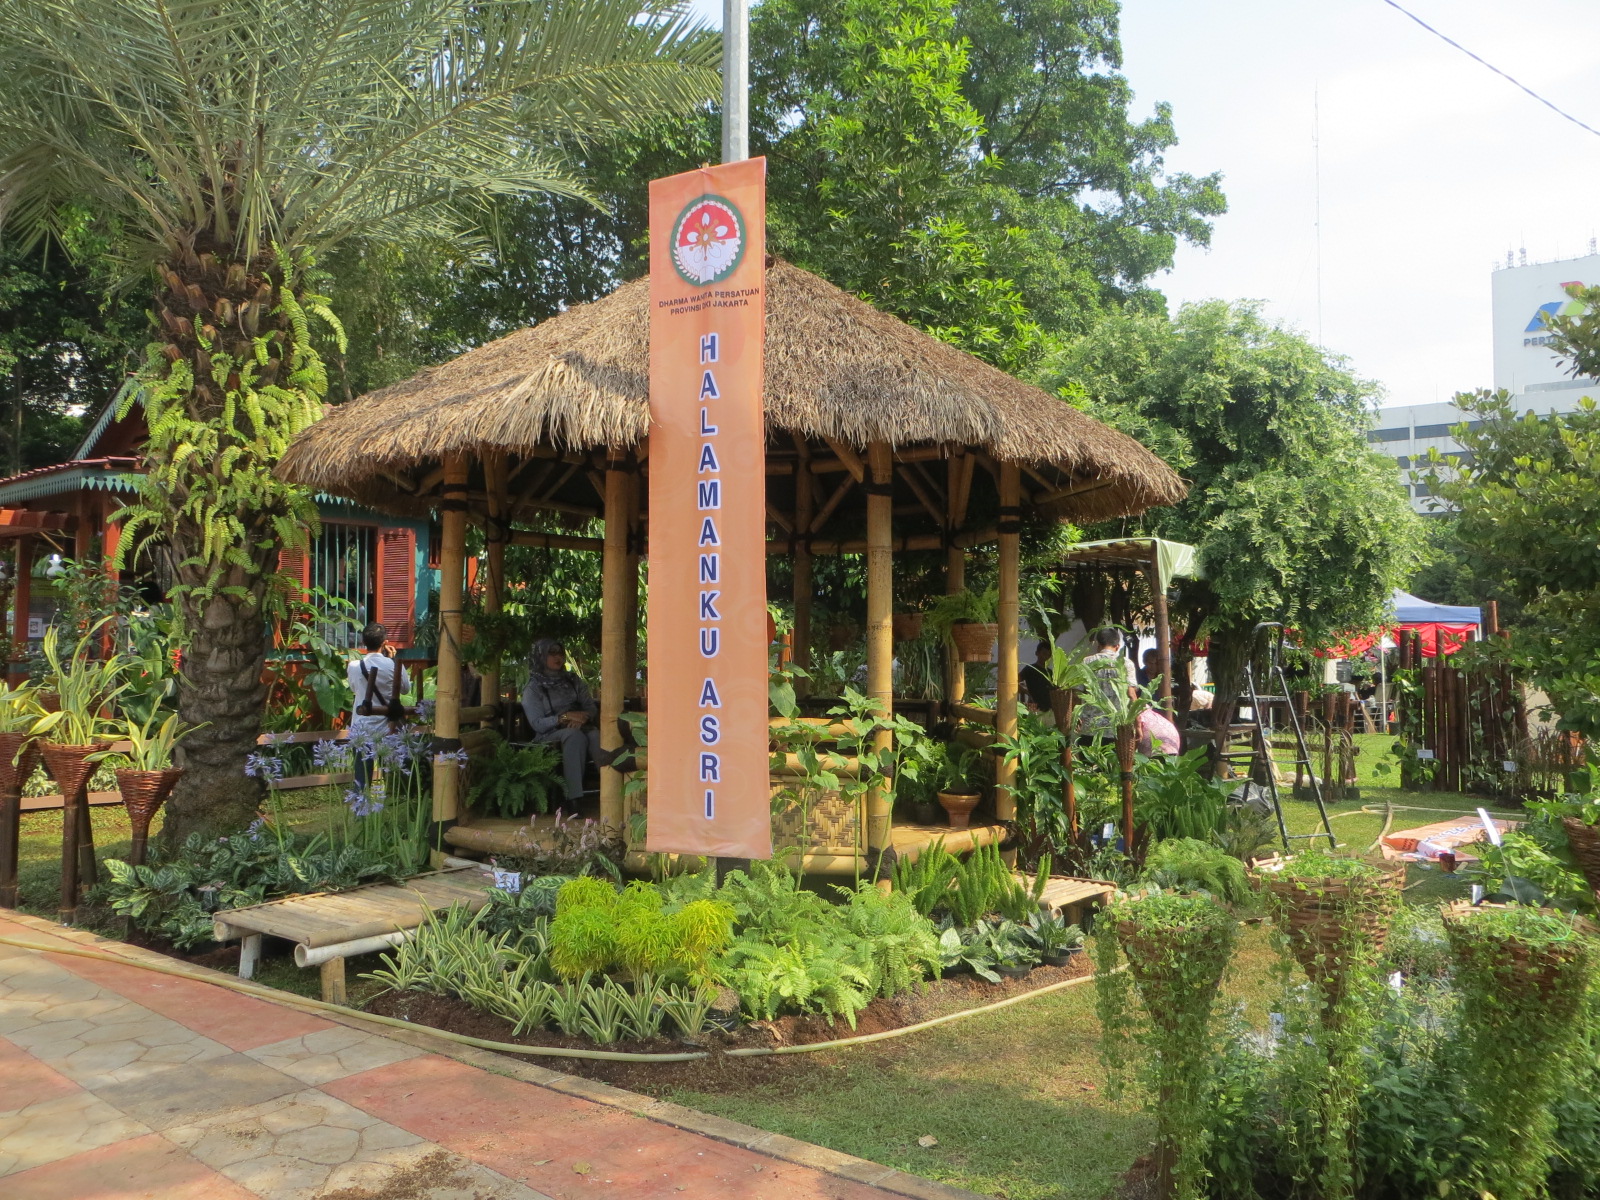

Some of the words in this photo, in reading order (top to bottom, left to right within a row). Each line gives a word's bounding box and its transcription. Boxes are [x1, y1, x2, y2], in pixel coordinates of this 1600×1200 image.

[658, 298, 689, 309] DHARMA
[714, 287, 760, 299] PERSATUAN
[670, 304, 702, 316] PROVINSI
[712, 299, 749, 308] JAKARTA
[698, 332, 721, 658] HALAMANKU
[699, 677, 721, 820] ASRI
